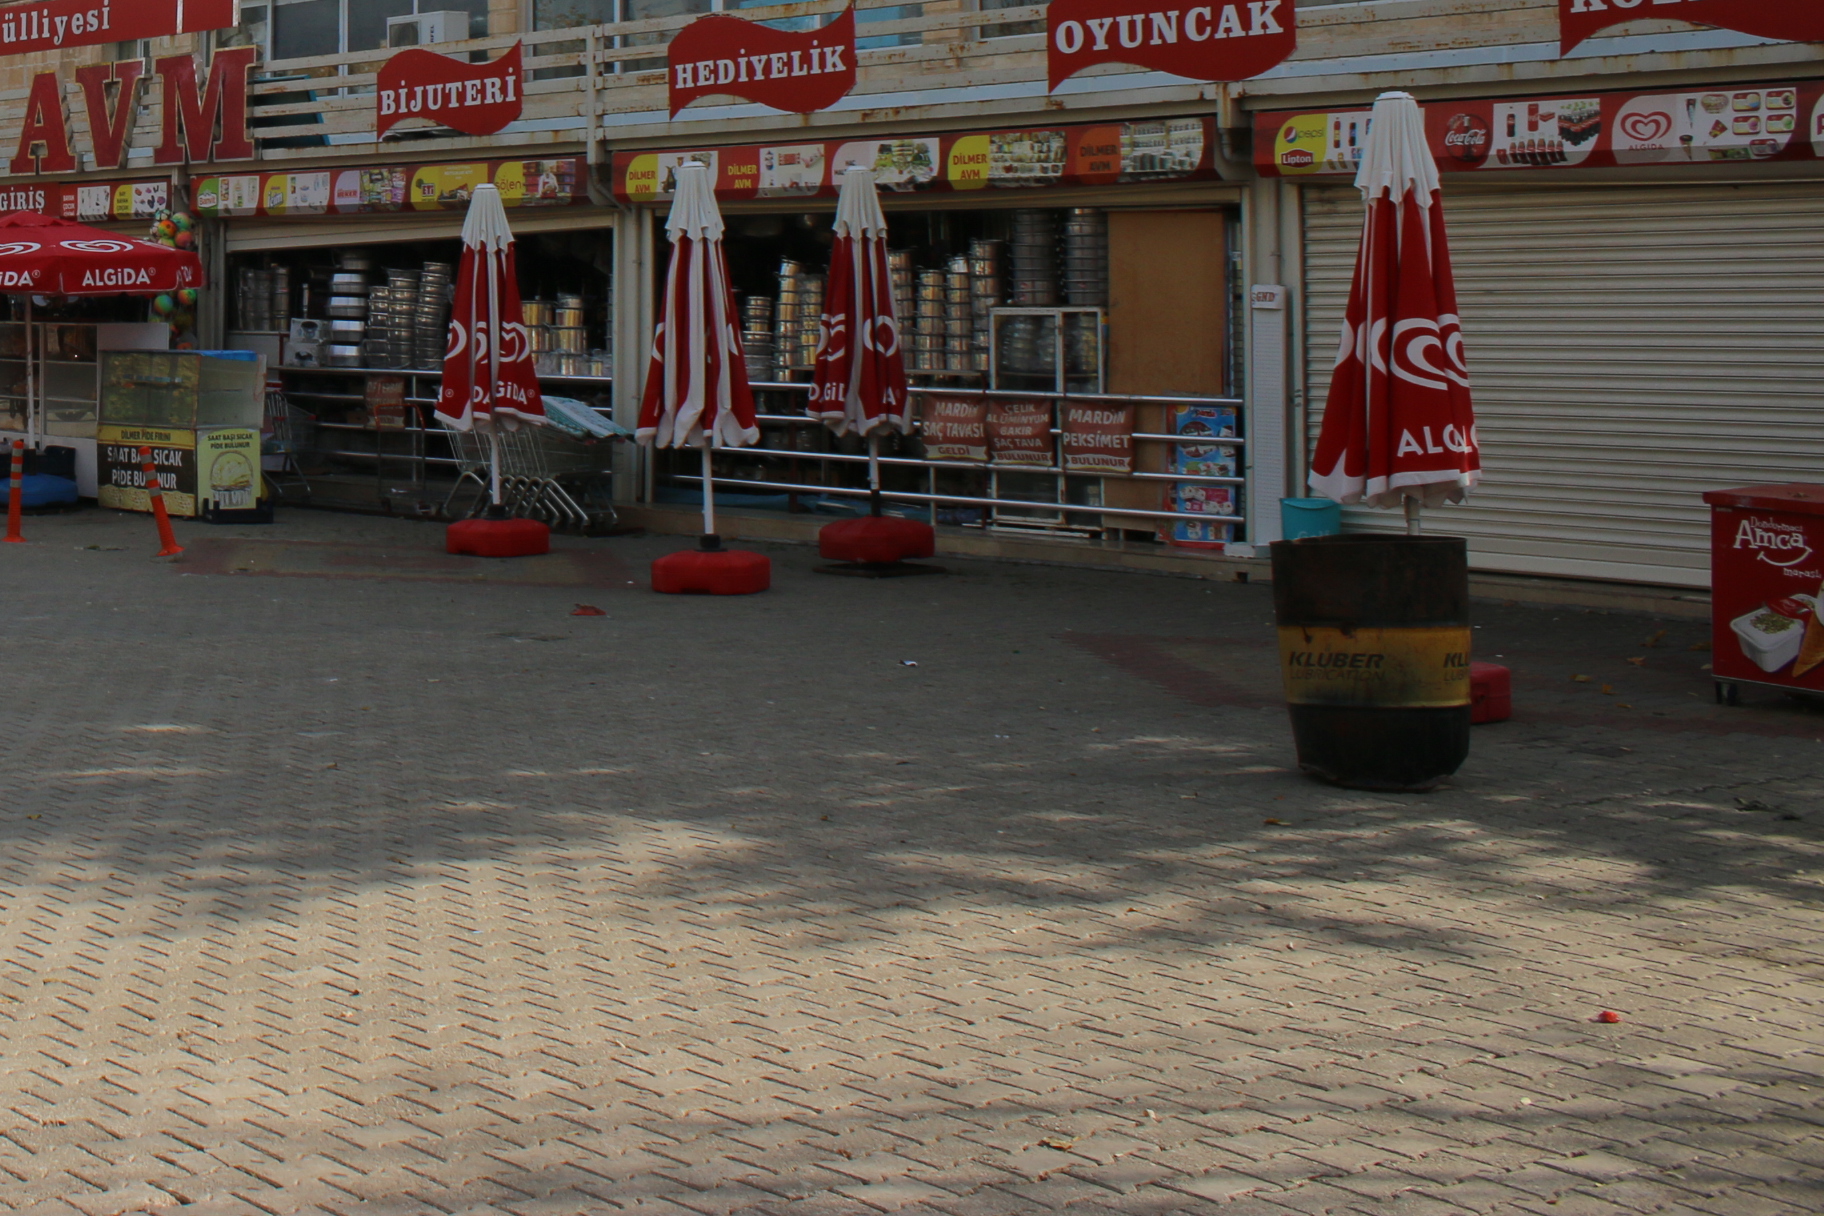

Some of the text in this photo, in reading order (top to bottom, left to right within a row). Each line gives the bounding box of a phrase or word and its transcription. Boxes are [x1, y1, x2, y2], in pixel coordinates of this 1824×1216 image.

[1055, 0, 1284, 54] OYUNCAK
[675, 39, 847, 89] HEDİYELİK
[380, 67, 517, 116] BİJUTERİ
[10, 45, 257, 175] AVM
[952, 151, 987, 165] DİLMER
[1283, 153, 1312, 165] Lipton
[629, 169, 656, 181] DİLMER
[728, 162, 757, 176] DİLMER
[960, 169, 981, 180] AVM
[635, 184, 651, 194] AVM
[734, 179, 752, 190] AVM
[1068, 409, 1126, 425] MARDİN
[946, 423, 985, 438] TAVASI
[1014, 438, 1043, 447] TAVA
[1063, 430, 1131, 449] PEKSİMET
[107, 446, 129, 463] SAAT
[153, 449, 182, 467] SICAK
[938, 446, 971, 456] GELDİ
[997, 452, 1049, 462] BULUNUR
[1071, 456, 1126, 467] BULUNUR
[112, 466, 177, 490] PİDE BUNUR
[1733, 519, 1804, 550] Amca
